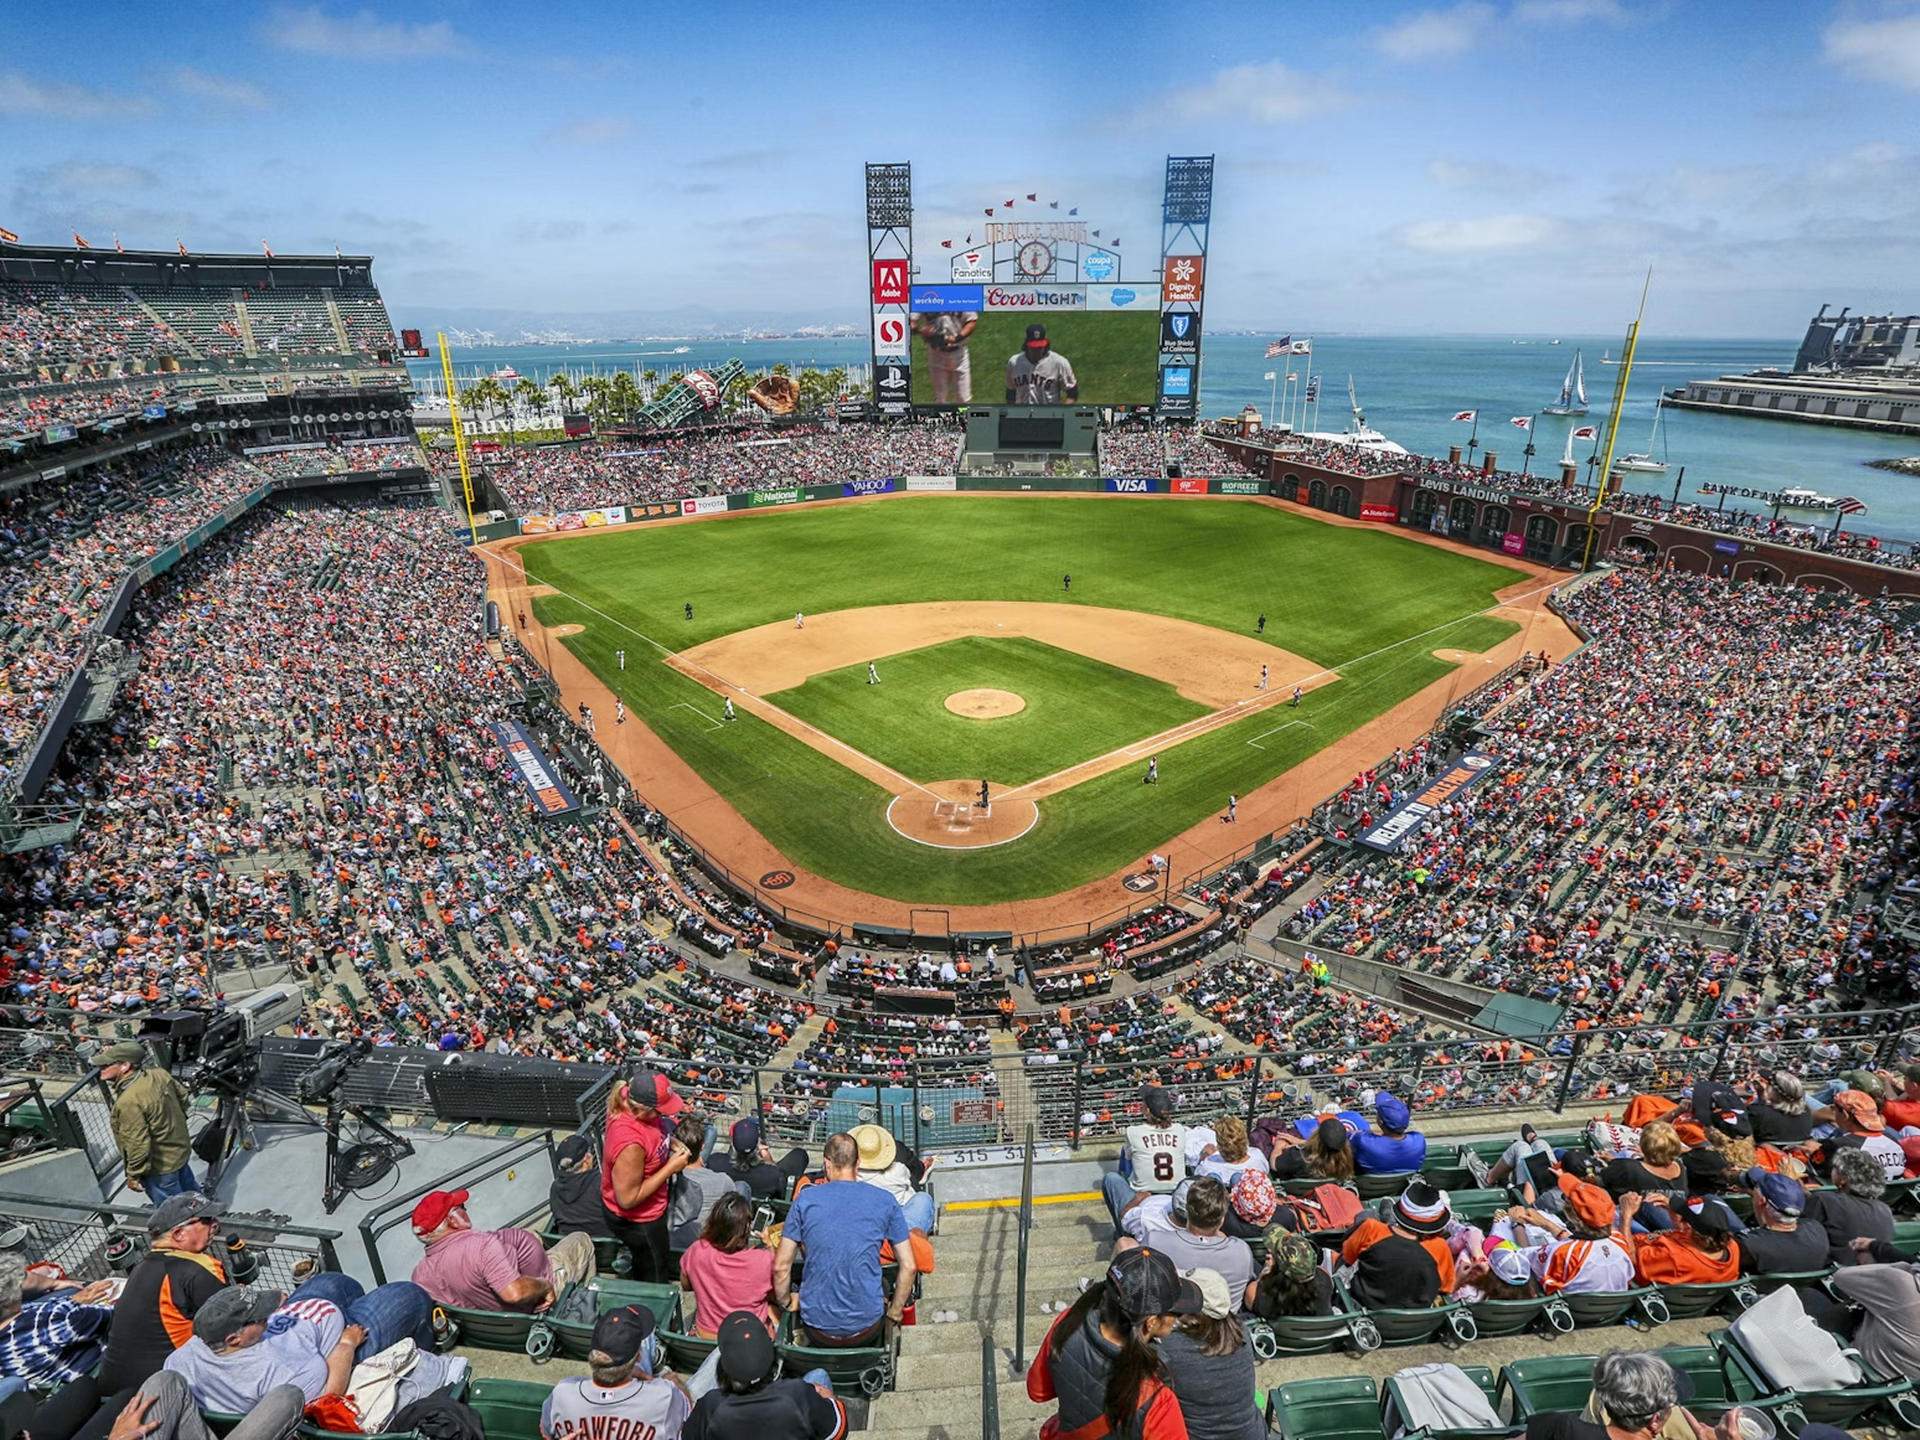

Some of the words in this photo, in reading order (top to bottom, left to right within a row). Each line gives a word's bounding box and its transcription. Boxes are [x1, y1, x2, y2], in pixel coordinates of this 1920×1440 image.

[985, 222, 1045, 244] ORACLE
[1049, 222, 1088, 244] PARK
[1088, 257, 1110, 265] coupa
[953, 268, 992, 279] Fanatics
[881, 290, 901, 298] Adobe
[1169, 283, 1195, 292] Dignity
[987, 287, 1035, 306] Coors
[1037, 293, 1079, 305] LIGHT
[1170, 292, 1195, 300] Health
[464, 416, 564, 435] nuveen
[851, 479, 887, 492] YAHOO!
[1114, 479, 1148, 492] VISA
[1221, 482, 1260, 490] BIOFREEZE
[763, 490, 798, 502] National
[1453, 484, 1510, 505] LANDING
[1703, 482, 1738, 496] BANK
[1741, 488, 1759, 500] OF
[1760, 491, 1828, 510] AMERICA
[698, 500, 726, 509] TOYOTA
[1365, 810, 1421, 846] WELCOME
[1405, 802, 1432, 814] TO
[1142, 1133, 1178, 1148] PENCE
[954, 1149, 988, 1164] 315
[1153, 1152, 1174, 1181] 8
